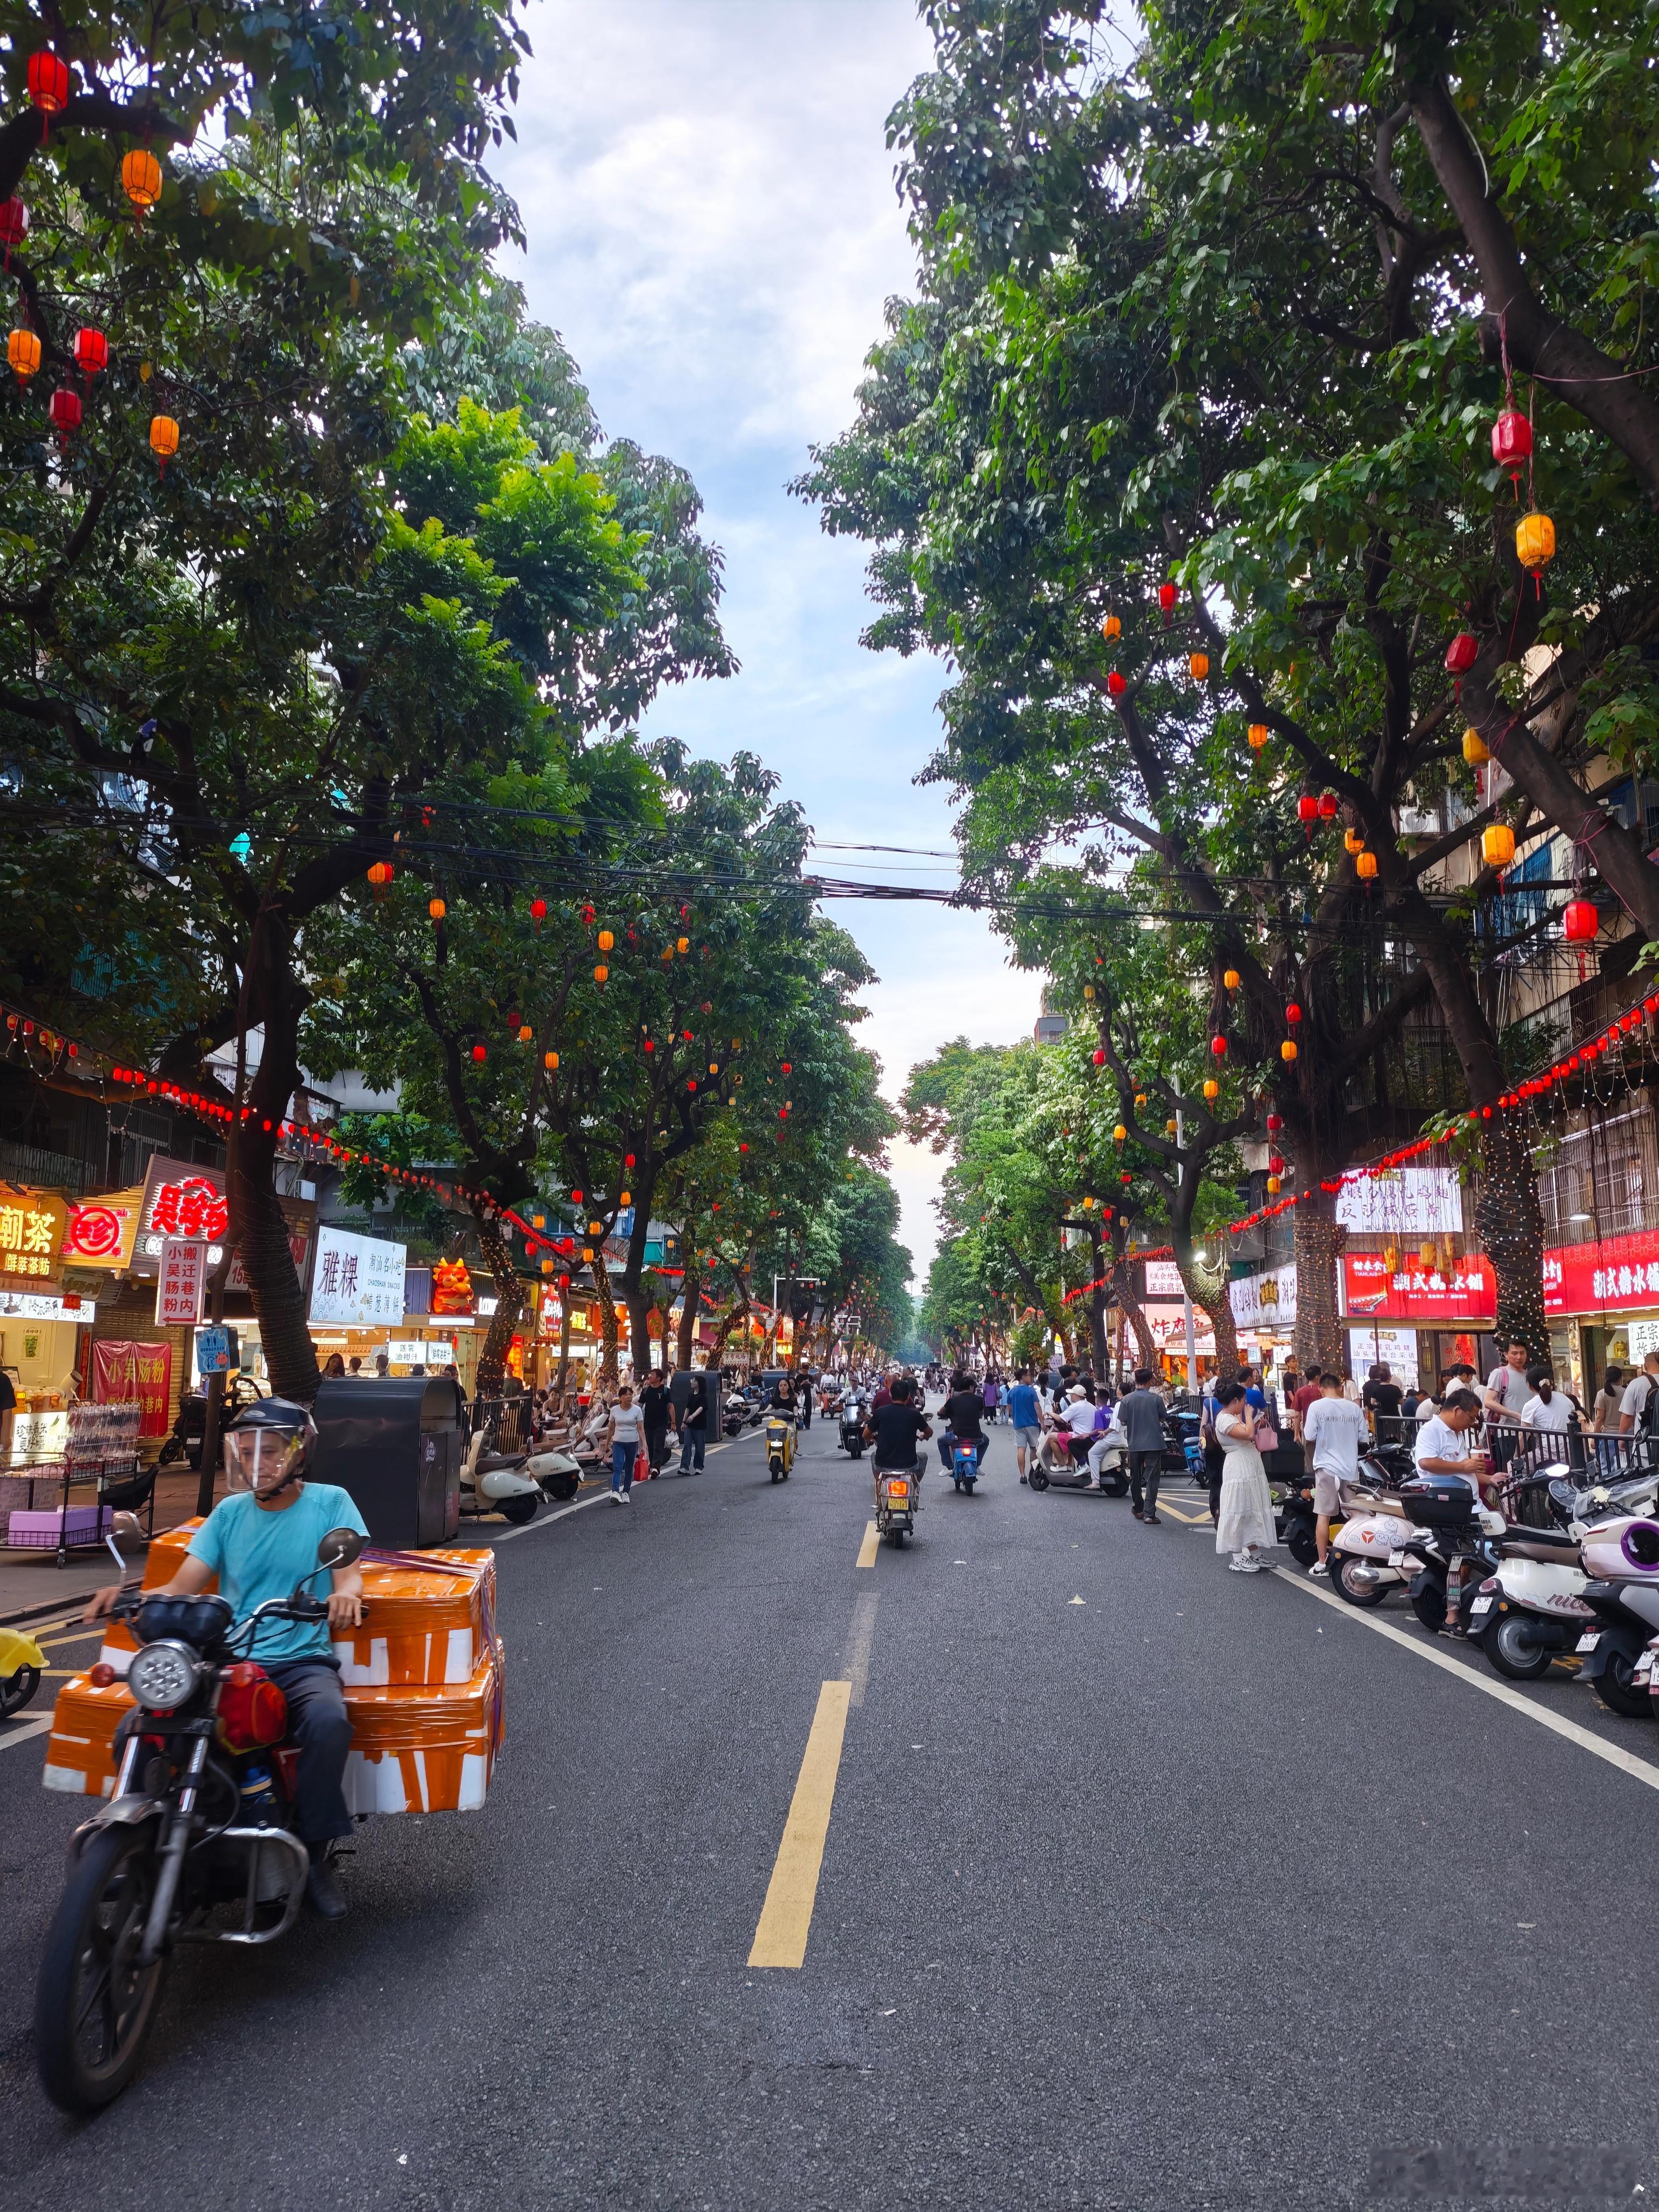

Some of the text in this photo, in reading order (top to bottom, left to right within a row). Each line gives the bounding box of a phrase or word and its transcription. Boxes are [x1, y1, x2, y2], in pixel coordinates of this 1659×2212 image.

[164, 1246, 181, 1312] 小吴肠粉
[180, 1246, 197, 1312] 搬迁巷内
[317, 1249, 358, 1298] 雅粿
